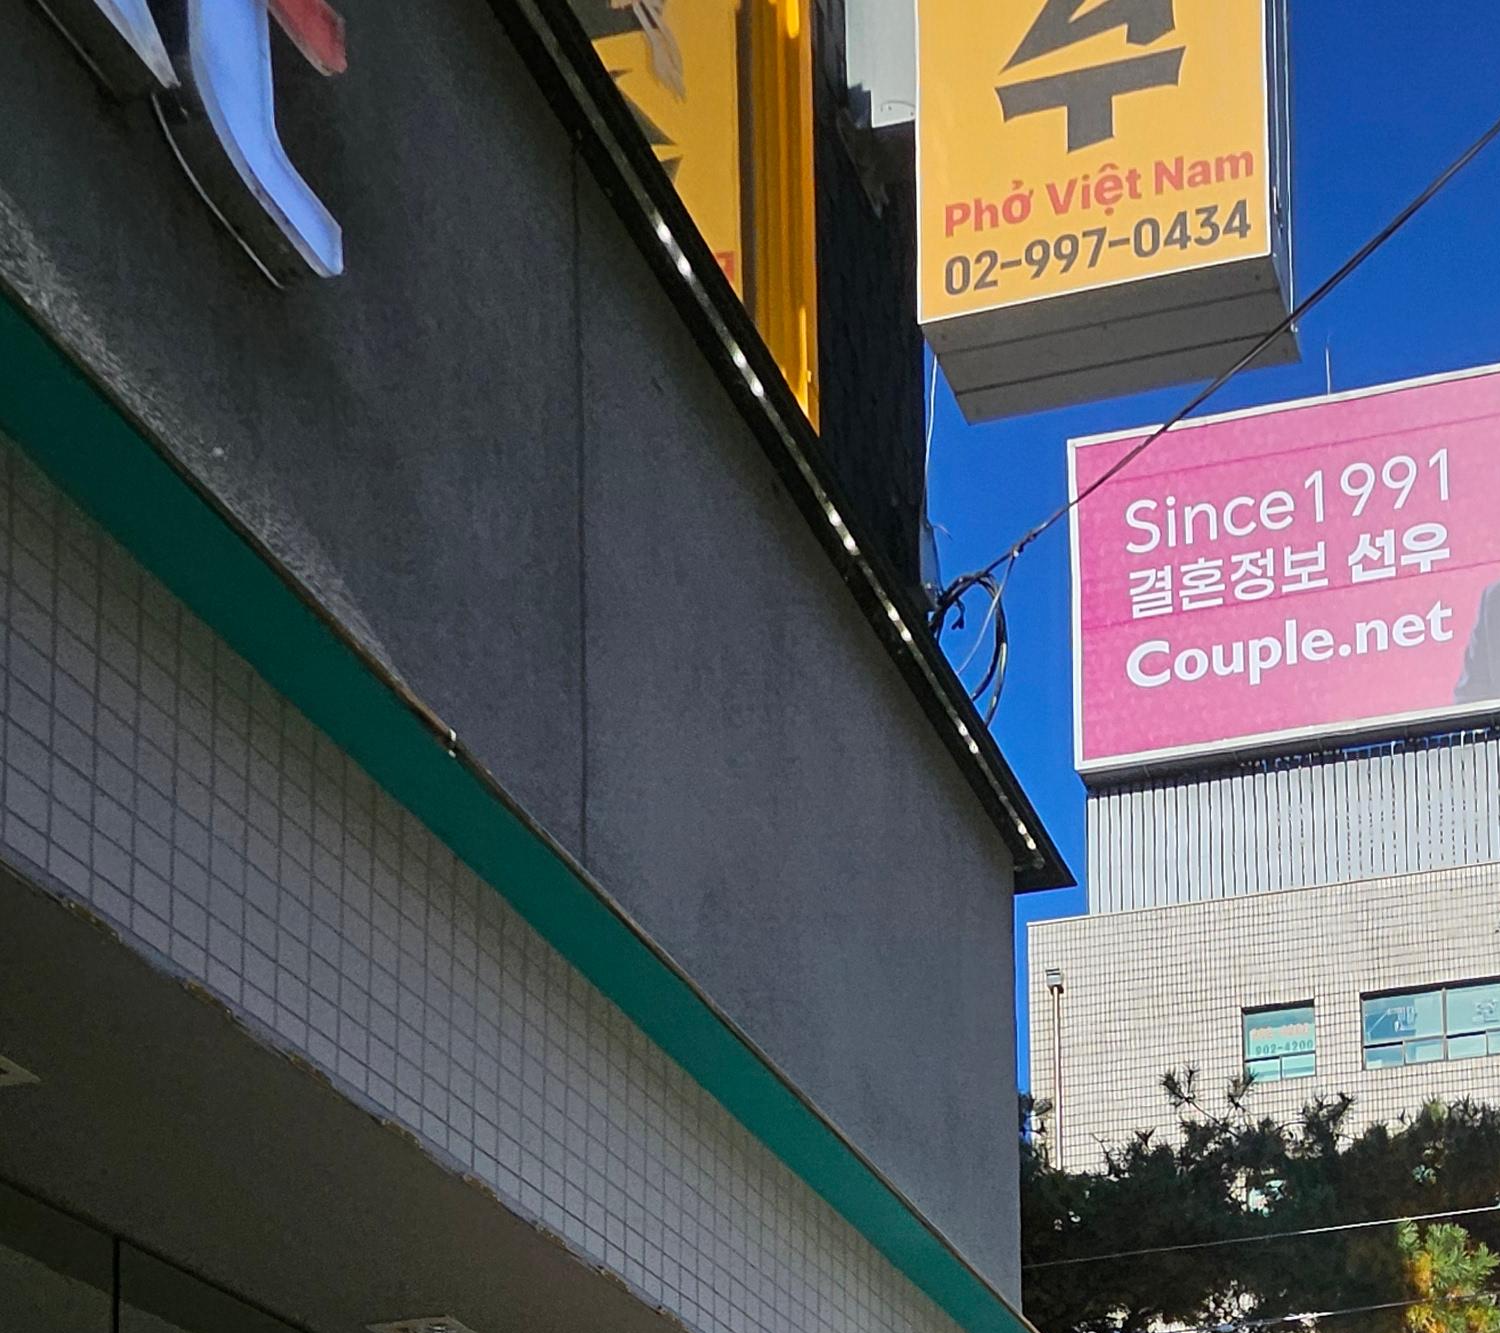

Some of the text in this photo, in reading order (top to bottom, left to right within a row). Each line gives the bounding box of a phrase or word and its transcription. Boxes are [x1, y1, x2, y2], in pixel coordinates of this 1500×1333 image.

[945, 150, 1254, 238] Phở Việt Nam
[945, 198, 1252, 296] 02-997-0434
[1128, 522, 1451, 619] 결혼정보 선우
[1126, 601, 1455, 688] Couple.net
